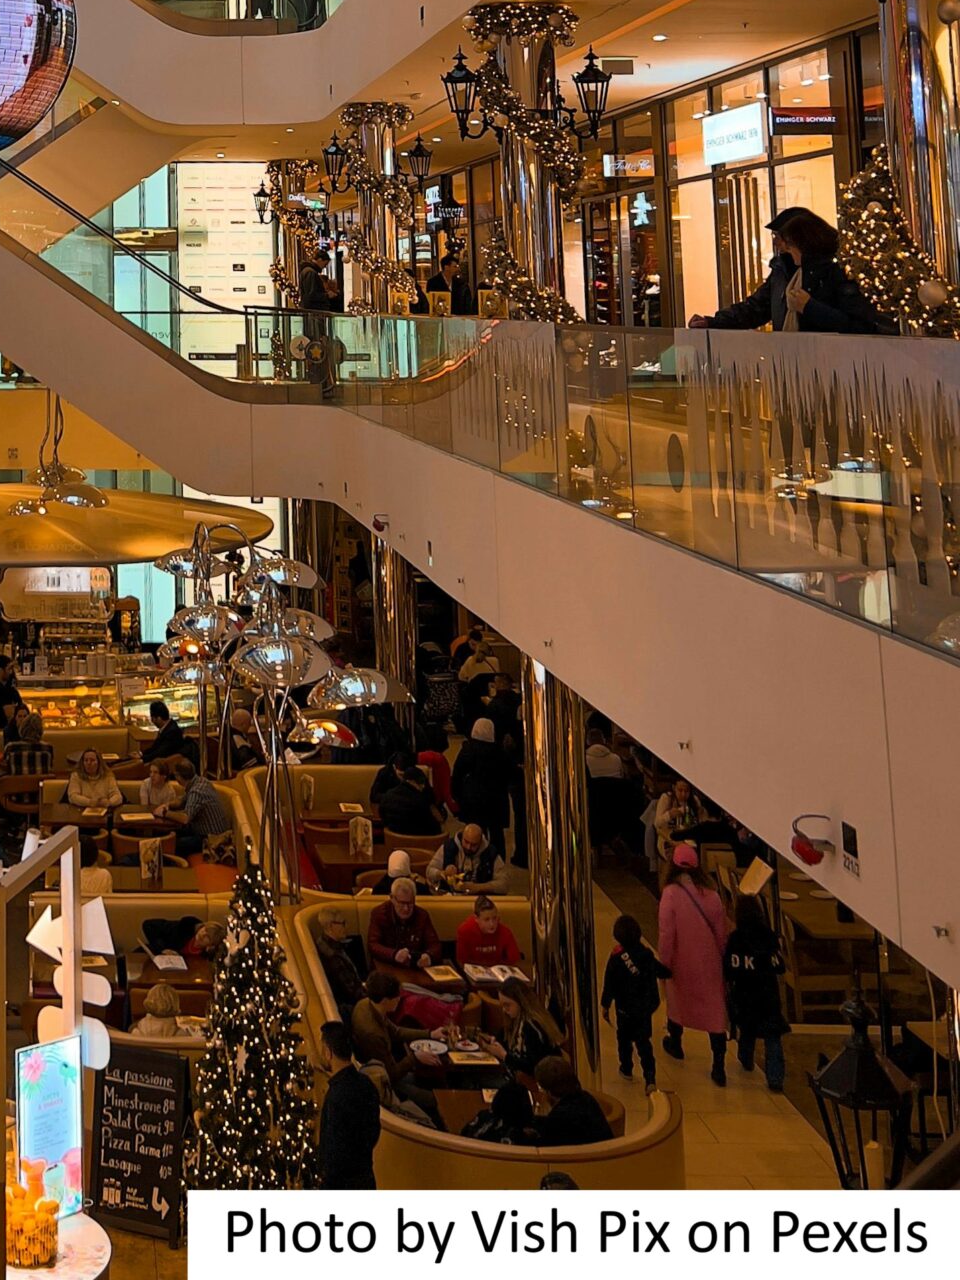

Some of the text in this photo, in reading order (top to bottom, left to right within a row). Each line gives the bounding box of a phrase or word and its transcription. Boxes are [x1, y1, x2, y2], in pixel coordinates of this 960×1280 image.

[124, 1070, 174, 1088] passione
[103, 1084, 162, 1114] Minestrone
[101, 1106, 131, 1130] Salat
[101, 1127, 131, 1151] Pizza
[134, 1133, 161, 1159] Parma
[100, 1148, 142, 1178] Lasagne
